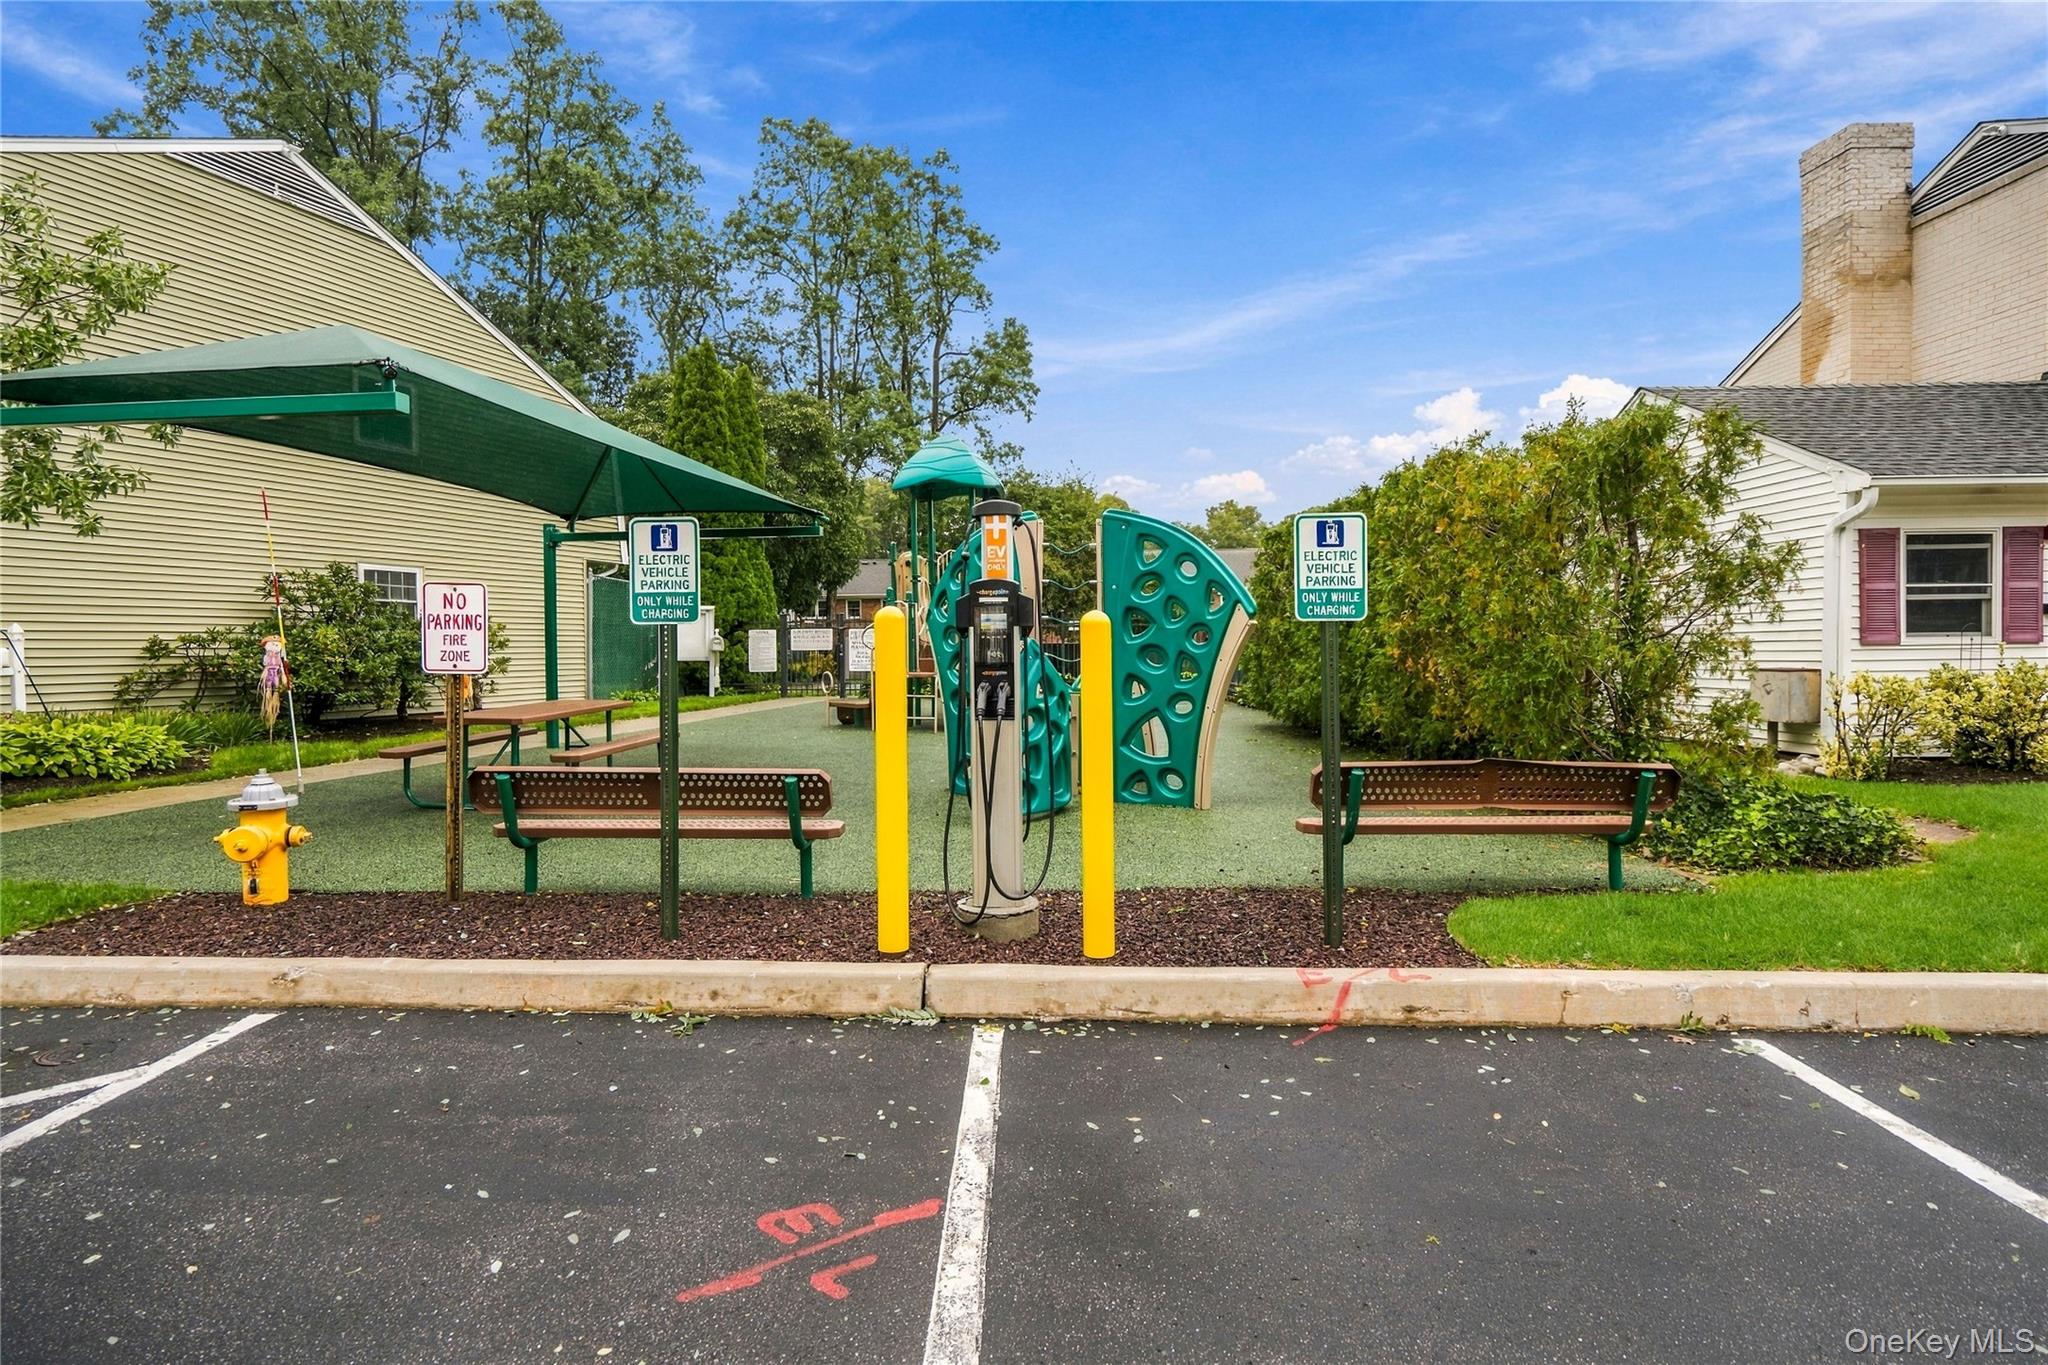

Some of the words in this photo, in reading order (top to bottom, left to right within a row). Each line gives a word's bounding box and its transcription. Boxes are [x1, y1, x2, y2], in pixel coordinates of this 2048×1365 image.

[987, 545, 1006, 559] EV
[1303, 550, 1358, 562] ELECTRIC
[638, 554, 690, 566] ELECTRIC
[641, 567, 689, 578] VEHICLE
[987, 563, 1006, 571] ONLY
[1306, 563, 1356, 574] VEHICLE
[640, 579, 690, 590] PARKING
[1305, 575, 1356, 587] PARKING
[443, 592, 467, 610] NO
[637, 595, 662, 607] ONLY
[665, 595, 694, 606] WHILE
[1302, 591, 1328, 603] ONLY
[1331, 591, 1361, 602] WHILE
[641, 608, 690, 619] CHARGING
[1306, 604, 1356, 616] CHARGING
[427, 613, 482, 631] PARKING
[443, 634, 468, 646] FIRE
[440, 650, 470, 662] ZONE
